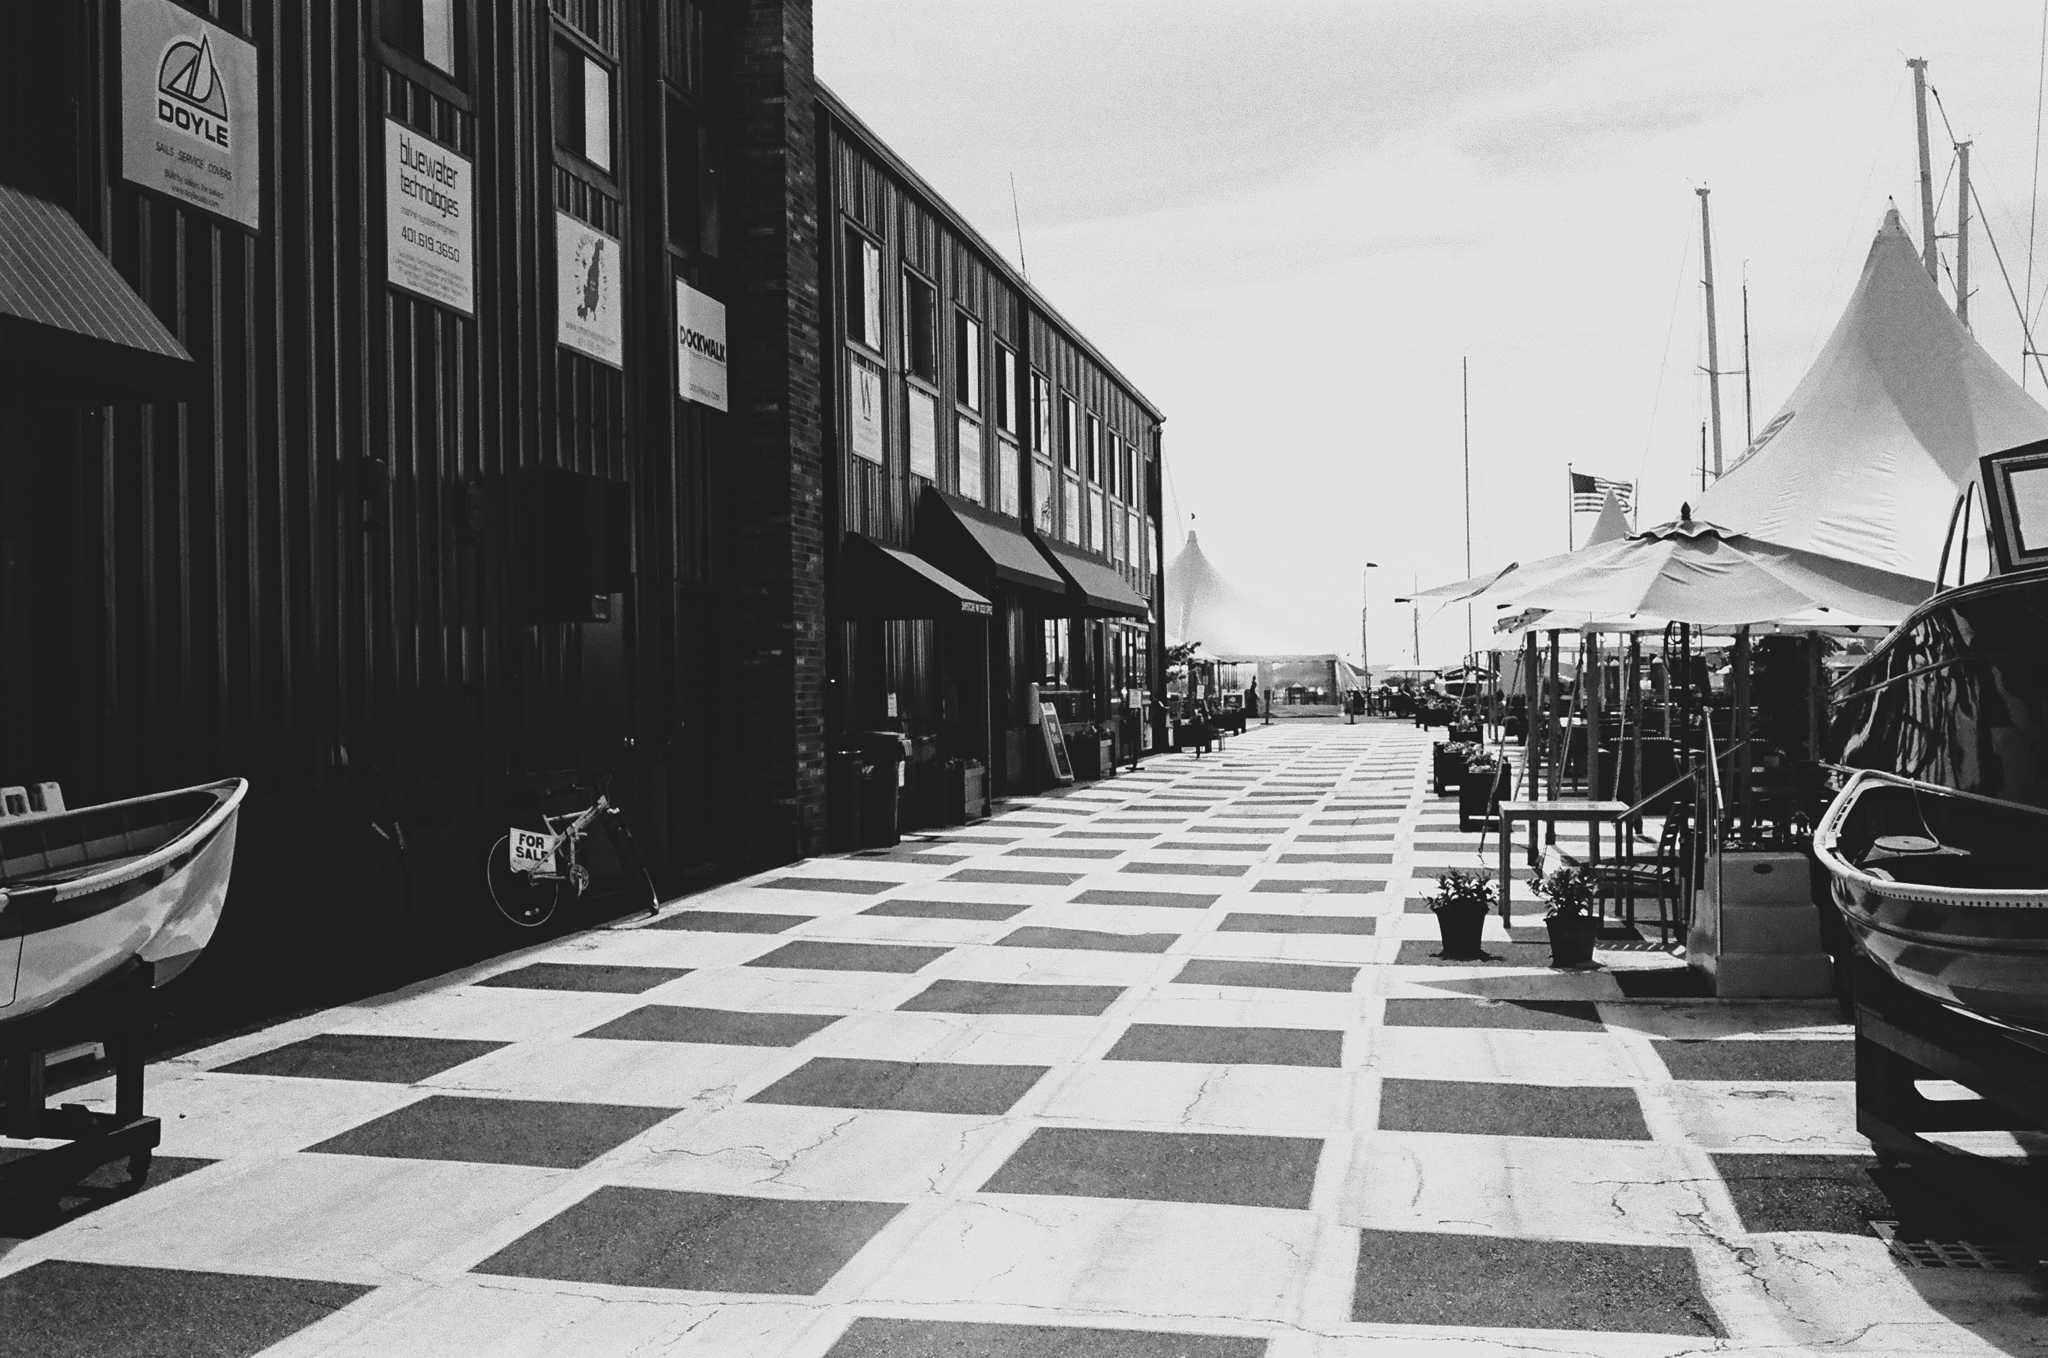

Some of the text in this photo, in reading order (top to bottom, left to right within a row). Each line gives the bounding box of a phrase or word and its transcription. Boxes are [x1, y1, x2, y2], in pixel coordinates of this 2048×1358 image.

[158, 98, 229, 148] DOYLE
[400, 133, 459, 190] bluewater
[679, 325, 726, 363] DOCKWALK
[515, 846, 549, 863] SALE
[519, 833, 545, 849] FOR
